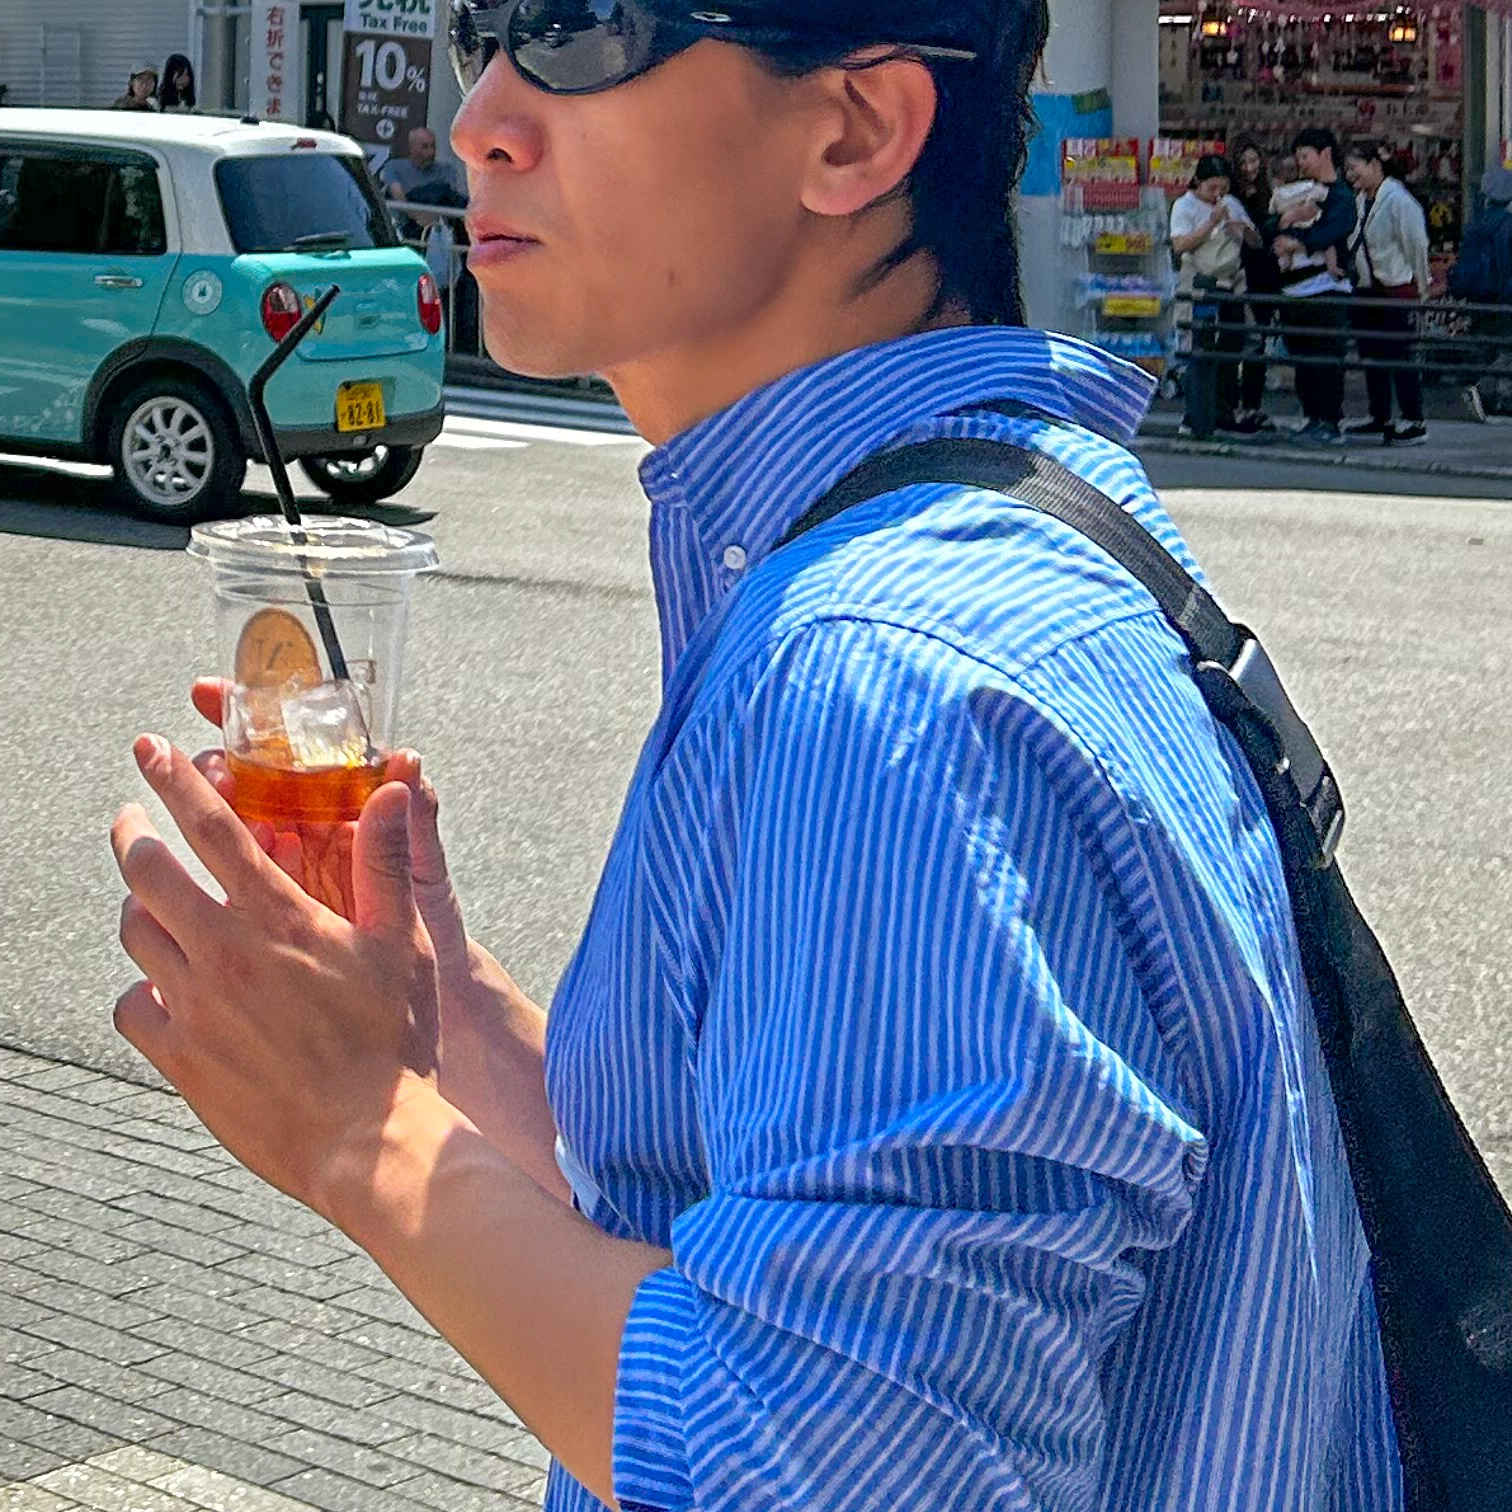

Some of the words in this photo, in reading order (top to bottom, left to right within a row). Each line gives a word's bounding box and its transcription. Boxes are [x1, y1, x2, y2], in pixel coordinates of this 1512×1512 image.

[360, 13, 388, 30] Tax
[393, 16, 428, 34] Free
[355, 39, 427, 94] 10%
